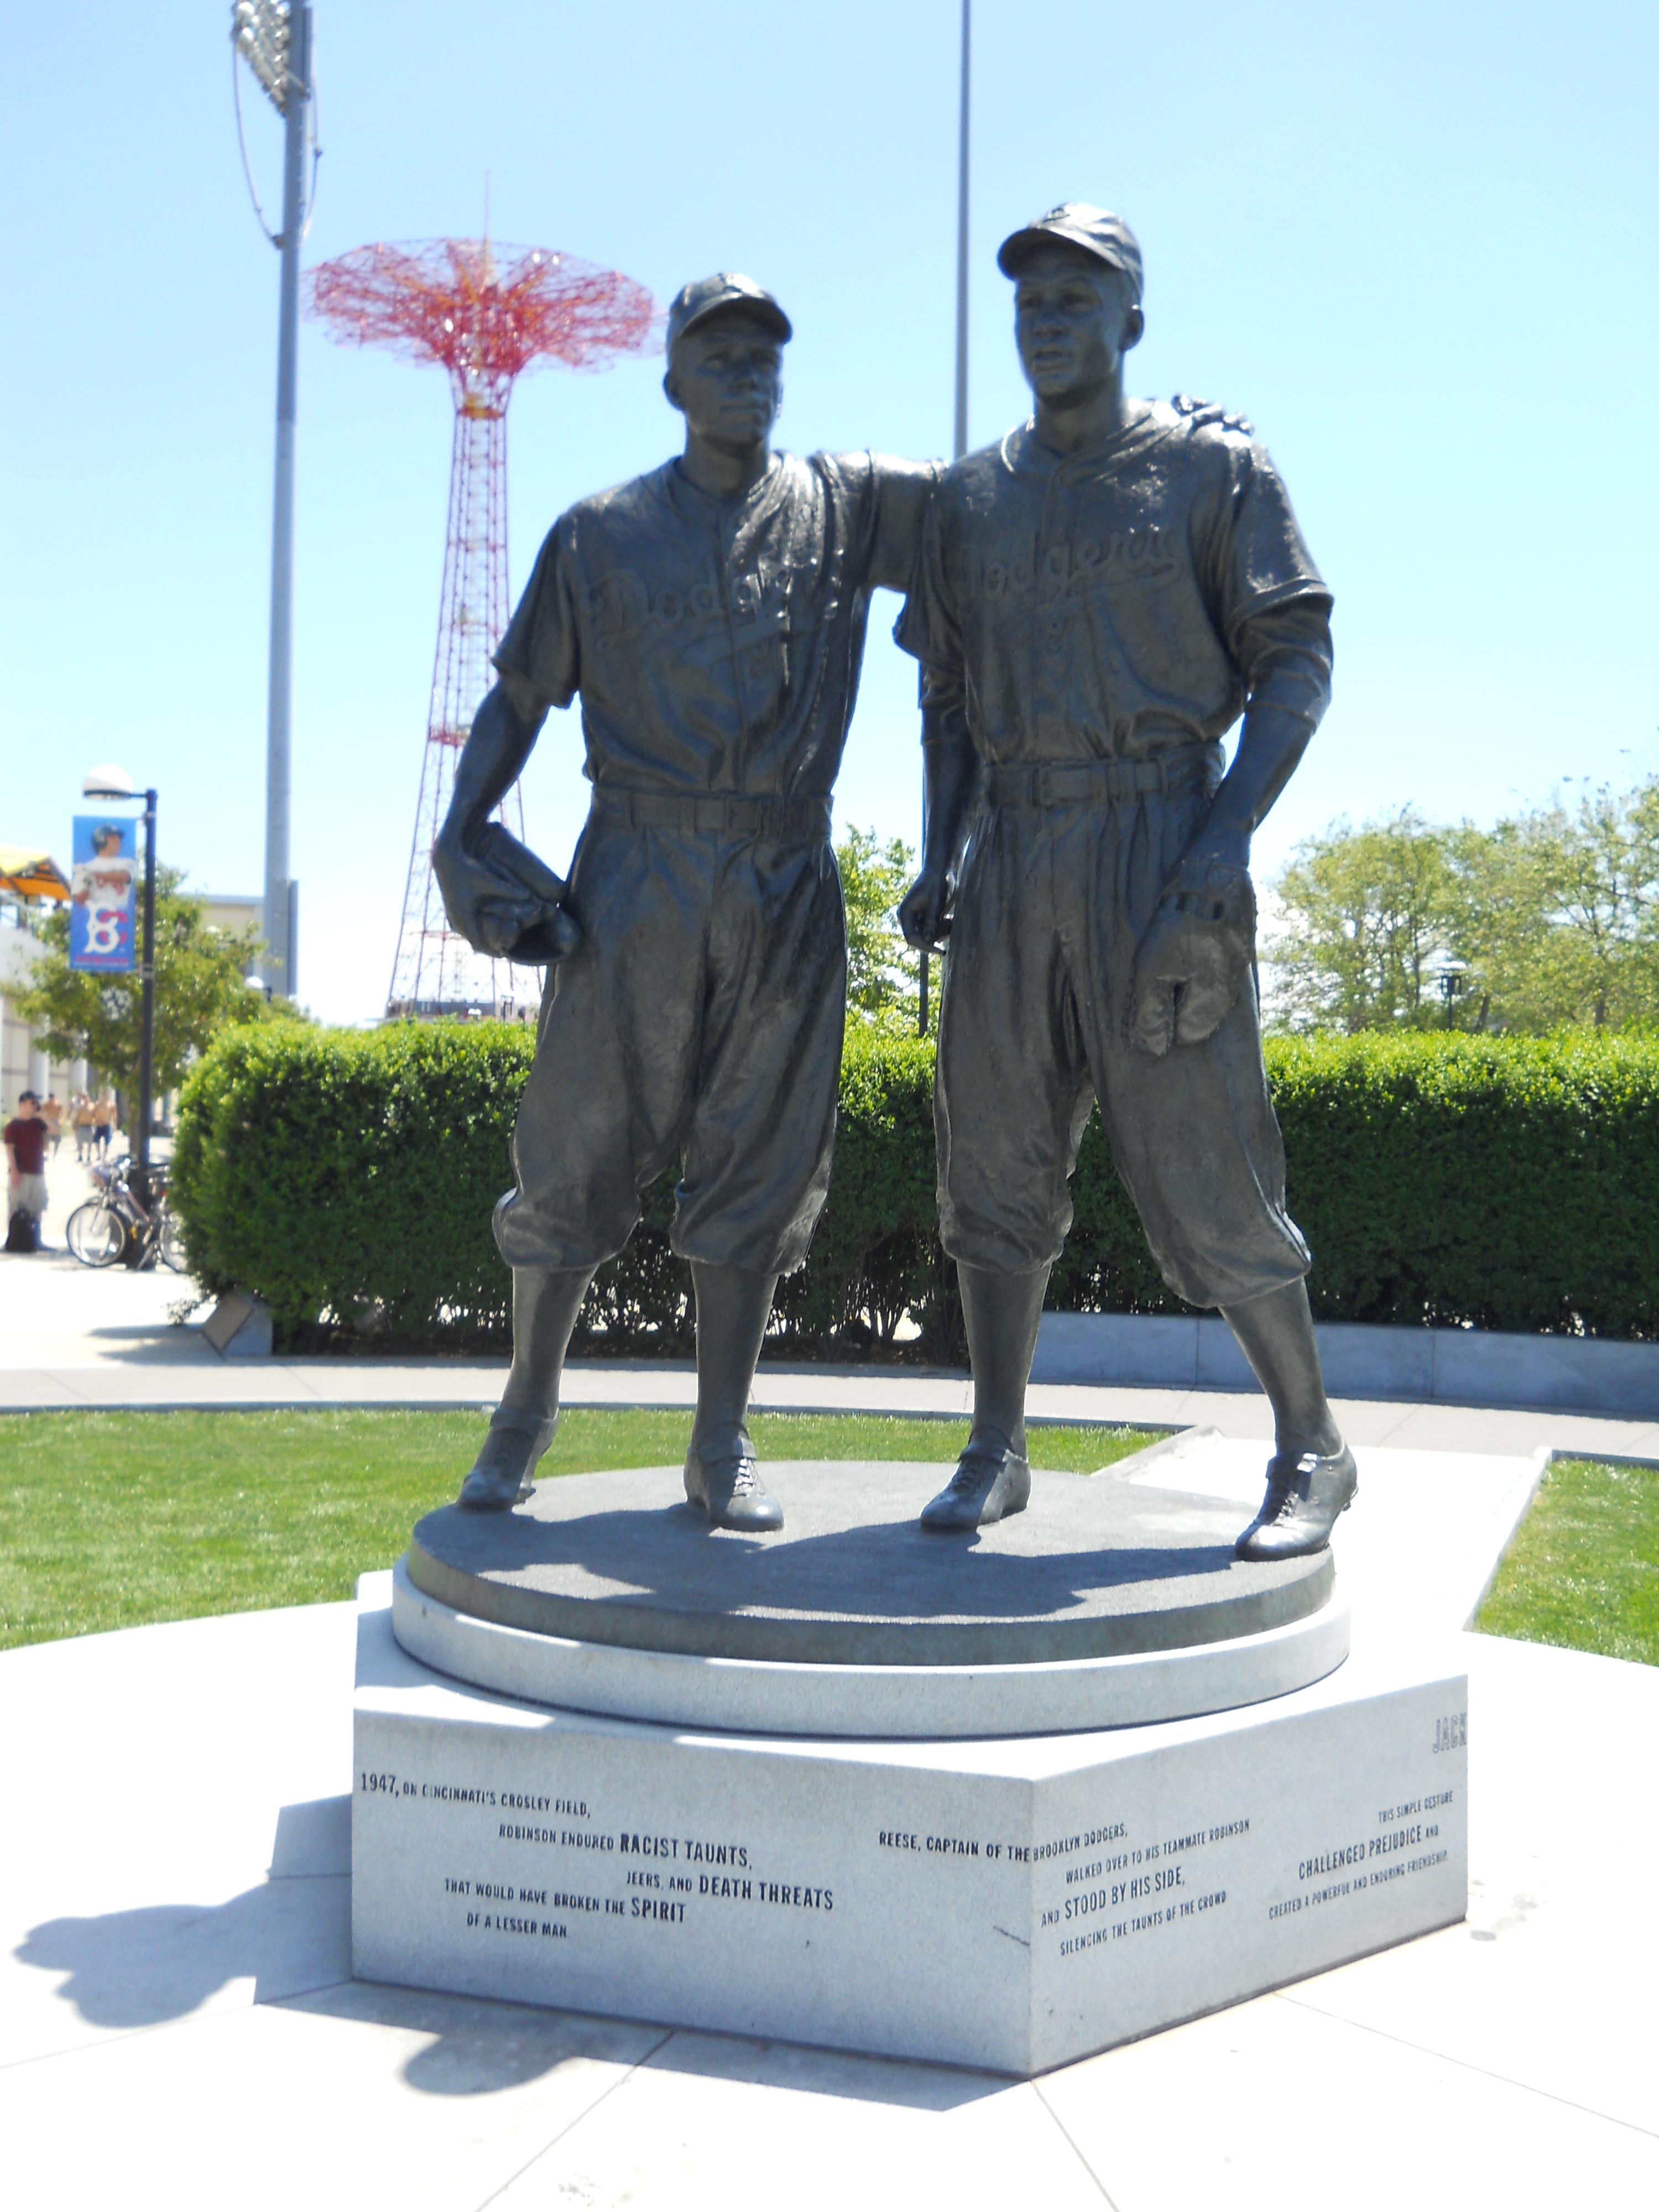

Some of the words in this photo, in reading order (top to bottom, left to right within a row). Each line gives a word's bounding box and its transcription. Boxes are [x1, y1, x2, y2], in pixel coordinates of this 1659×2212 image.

[361, 1772, 399, 1798] 1947,
[403, 1782, 418, 1796] ON
[501, 1793, 550, 1812] CROSLEY
[555, 1799, 591, 1818] FIELD,
[1396, 1801, 1421, 1818] SIMPLE
[1424, 1791, 1453, 1811] GESTURE
[499, 1824, 556, 1843] ROBINSON
[561, 1832, 614, 1851] ENDURED
[620, 1833, 679, 1859] RACIST
[685, 1841, 752, 1870] TAUNTS,
[879, 1832, 921, 1851] REESE,
[927, 1836, 979, 1856] CAPTAIN
[986, 1845, 1001, 1859] OF
[1008, 1846, 1030, 1863] THE
[1033, 1836, 1080, 1863] BROOKLYN
[1084, 1822, 1128, 1848] DODGERS,
[1066, 1861, 1103, 1884] WALKED
[1106, 1855, 1128, 1872] OVER
[1131, 1851, 1142, 1865] TO
[1146, 1845, 1159, 1861] HIS
[1162, 1831, 1206, 1856] TEAMMATE
[1209, 1818, 1250, 1841] ROBINSON
[1298, 1844, 1365, 1880] CHALLENGED
[1369, 1825, 1422, 1858] PREJUDICE
[1425, 1825, 1438, 1839] AND
[445, 1878, 471, 1895] THAT
[476, 1882, 514, 1901] WOULD
[520, 1888, 546, 1905] HAVE
[554, 1892, 599, 1911] BROKEN
[604, 1899, 625, 1914] THE
[632, 1897, 686, 1923] SPIRIT
[669, 1877, 692, 1891] AND
[700, 1875, 752, 1900] DEATH
[759, 1882, 833, 1910] THREATS
[1041, 1910, 1059, 1928] AND
[1065, 1890, 1107, 1920] STOOD
[1112, 1884, 1125, 1906] BY
[1130, 1876, 1150, 1900] HIS
[1155, 1866, 1186, 1893] SIDE,
[1268, 1898, 1302, 1920] CREATED
[1304, 1895, 1309, 1907] A
[1312, 1884, 1350, 1905] POWERFUL
[1353, 1877, 1366, 1891] AND
[467, 1912, 479, 1927] OF
[484, 1915, 491, 1928] A
[497, 1916, 537, 1934] LESSER
[1060, 1928, 1108, 1957] SILENCING
[1112, 1922, 1128, 1940] THE
[1131, 1912, 1162, 1933] TAUNTS
[1166, 1906, 1176, 1922] OF
[1180, 1901, 1194, 1917] THE
[1198, 1890, 1227, 1912] CROWD
